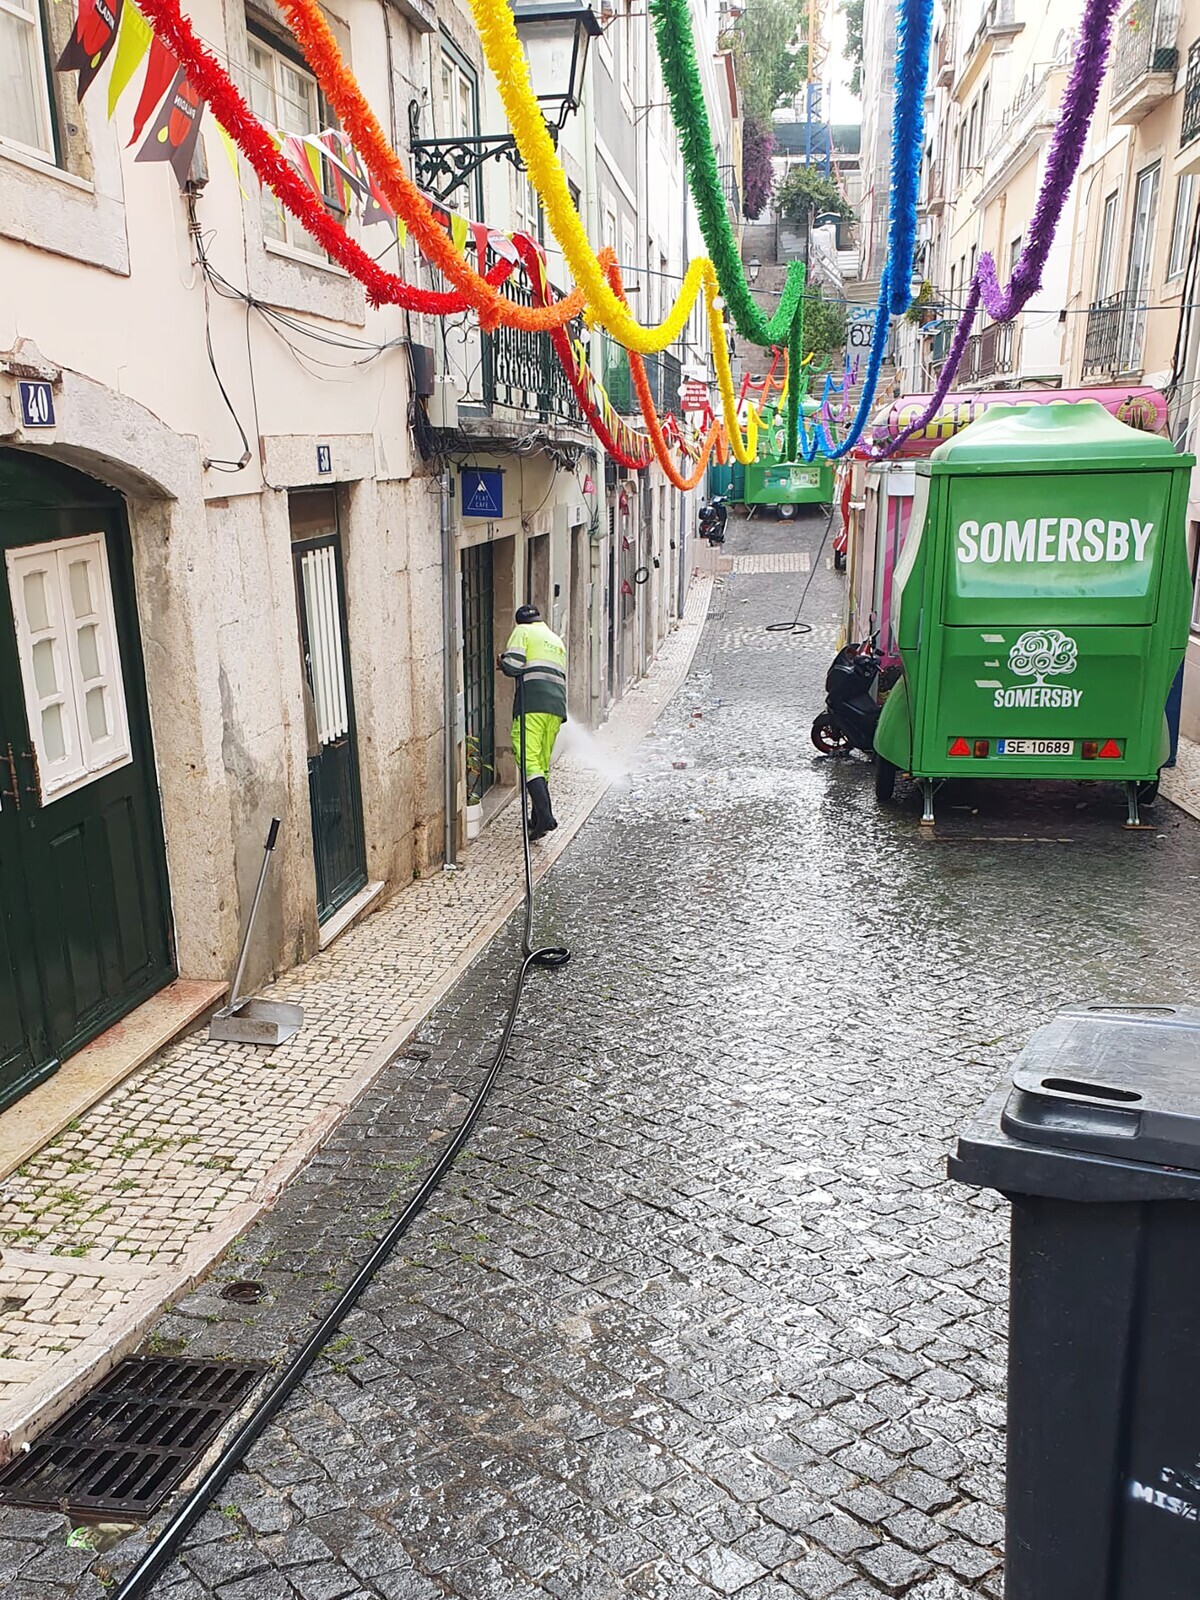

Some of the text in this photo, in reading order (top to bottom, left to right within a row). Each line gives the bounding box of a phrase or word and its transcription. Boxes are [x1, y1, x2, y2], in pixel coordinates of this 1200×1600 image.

[28, 385, 49, 423] 40
[319, 447, 330, 471] 38
[957, 518, 1154, 563] SOMERSBY
[993, 688, 1083, 707] SOMERSBY
